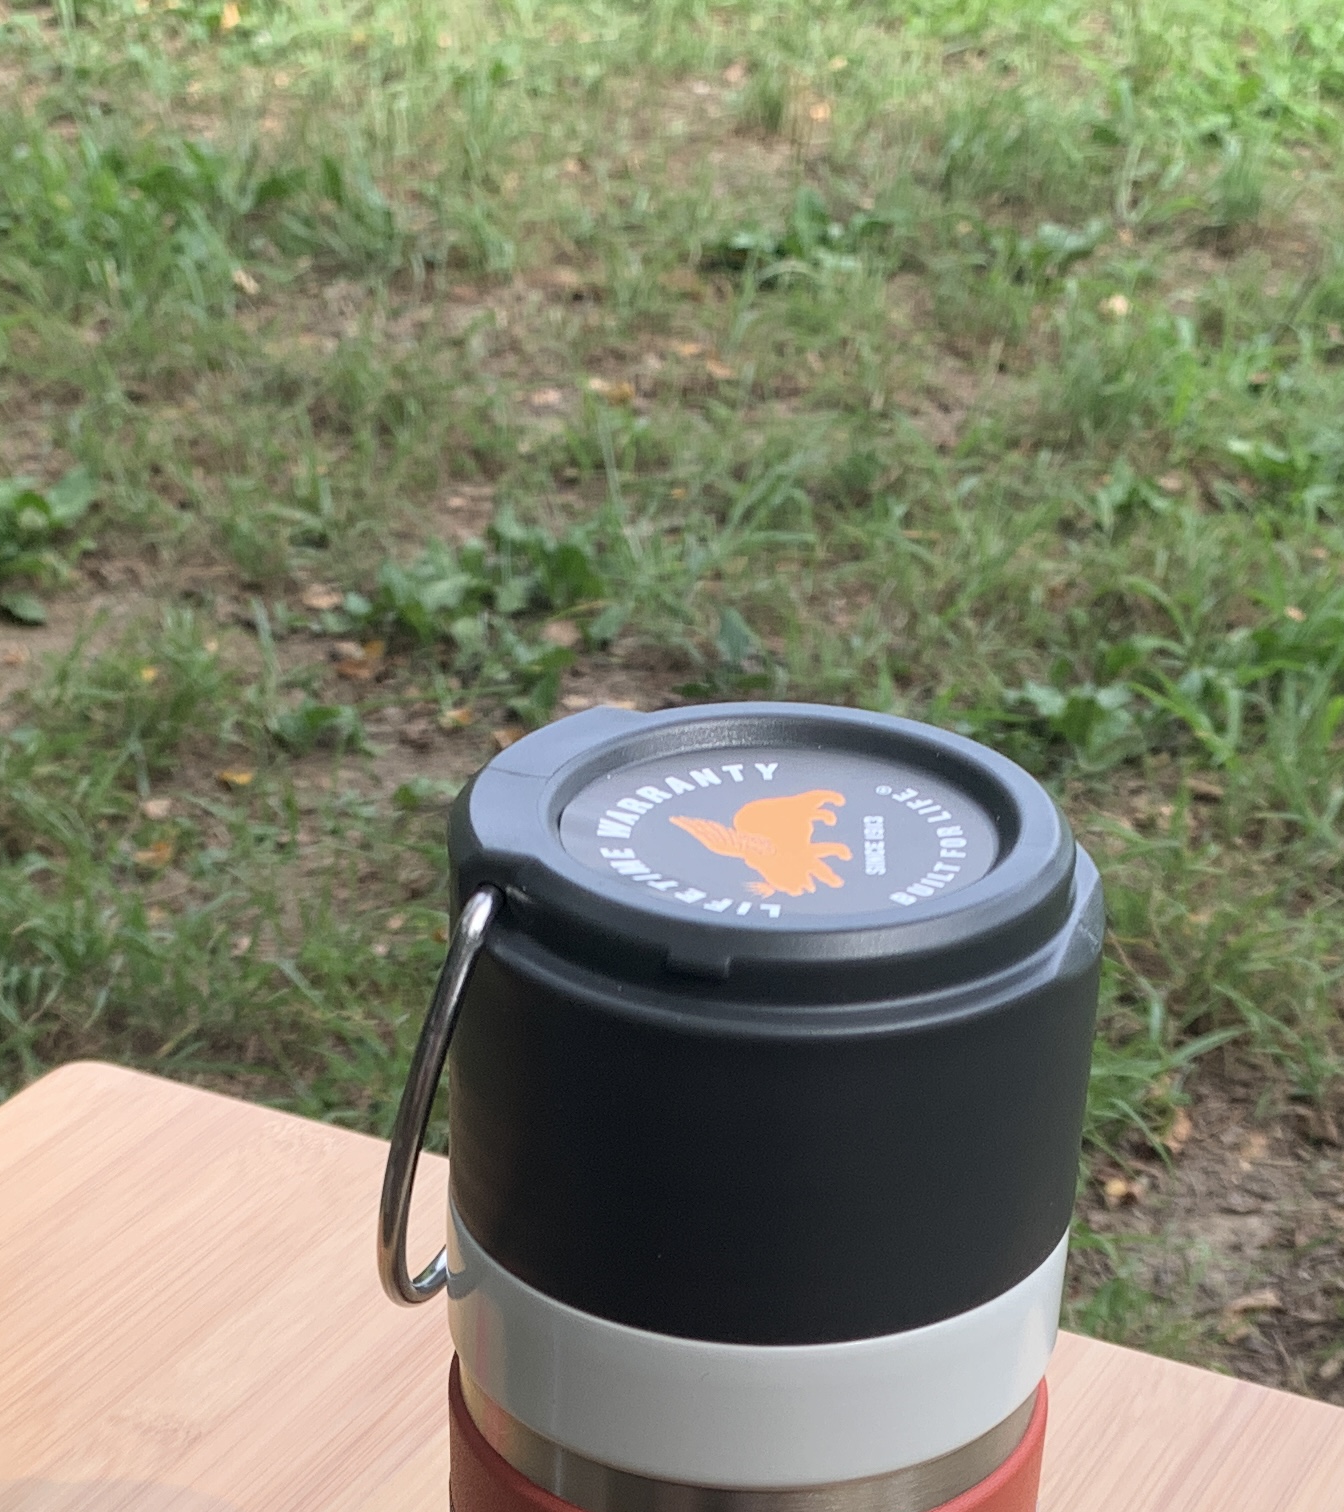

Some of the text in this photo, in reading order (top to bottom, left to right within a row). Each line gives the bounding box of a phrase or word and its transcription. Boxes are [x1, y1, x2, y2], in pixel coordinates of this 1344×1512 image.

[596, 762, 782, 919] LIFETIME WARRANTY
[864, 840, 887, 876] SINCE
[889, 861, 961, 906] BUILT
[936, 825, 967, 859] FOR
